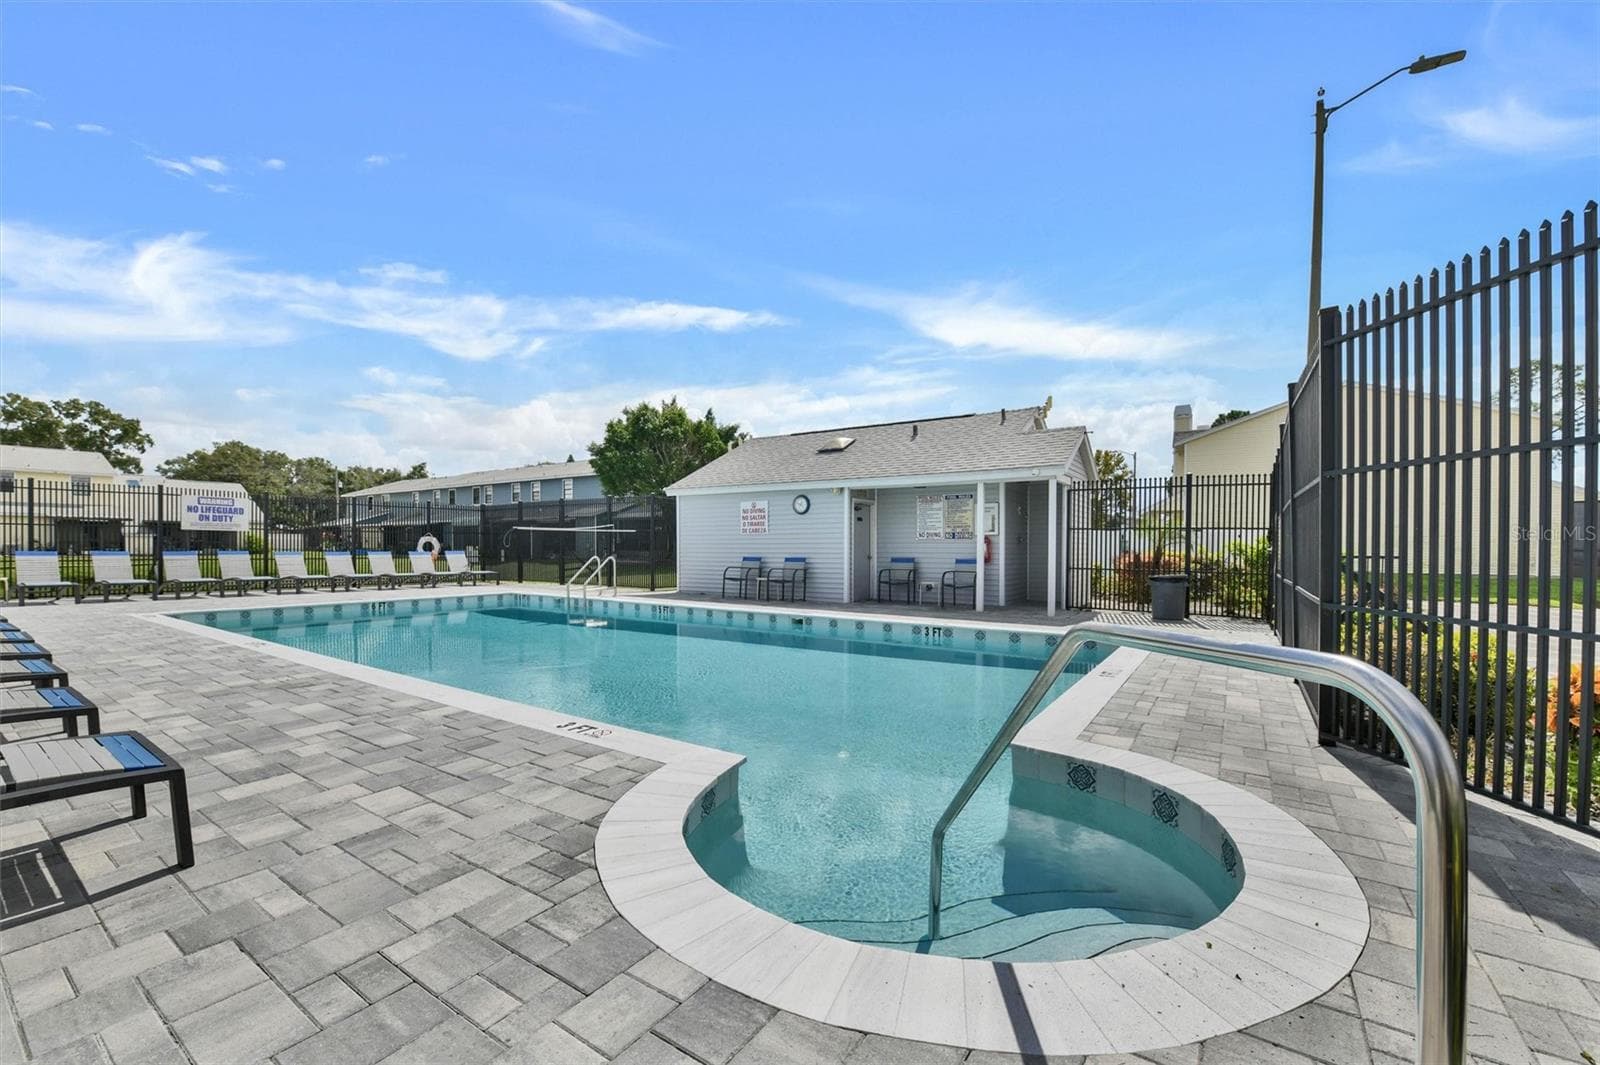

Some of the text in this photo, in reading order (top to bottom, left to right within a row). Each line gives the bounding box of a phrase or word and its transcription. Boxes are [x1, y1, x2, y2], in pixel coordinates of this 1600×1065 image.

[187, 505, 244, 515] NO LIFEGUARD
[211, 514, 234, 522] DUTY
[924, 626, 942, 637] 3 FT
[556, 721, 599, 734] 3 FT
